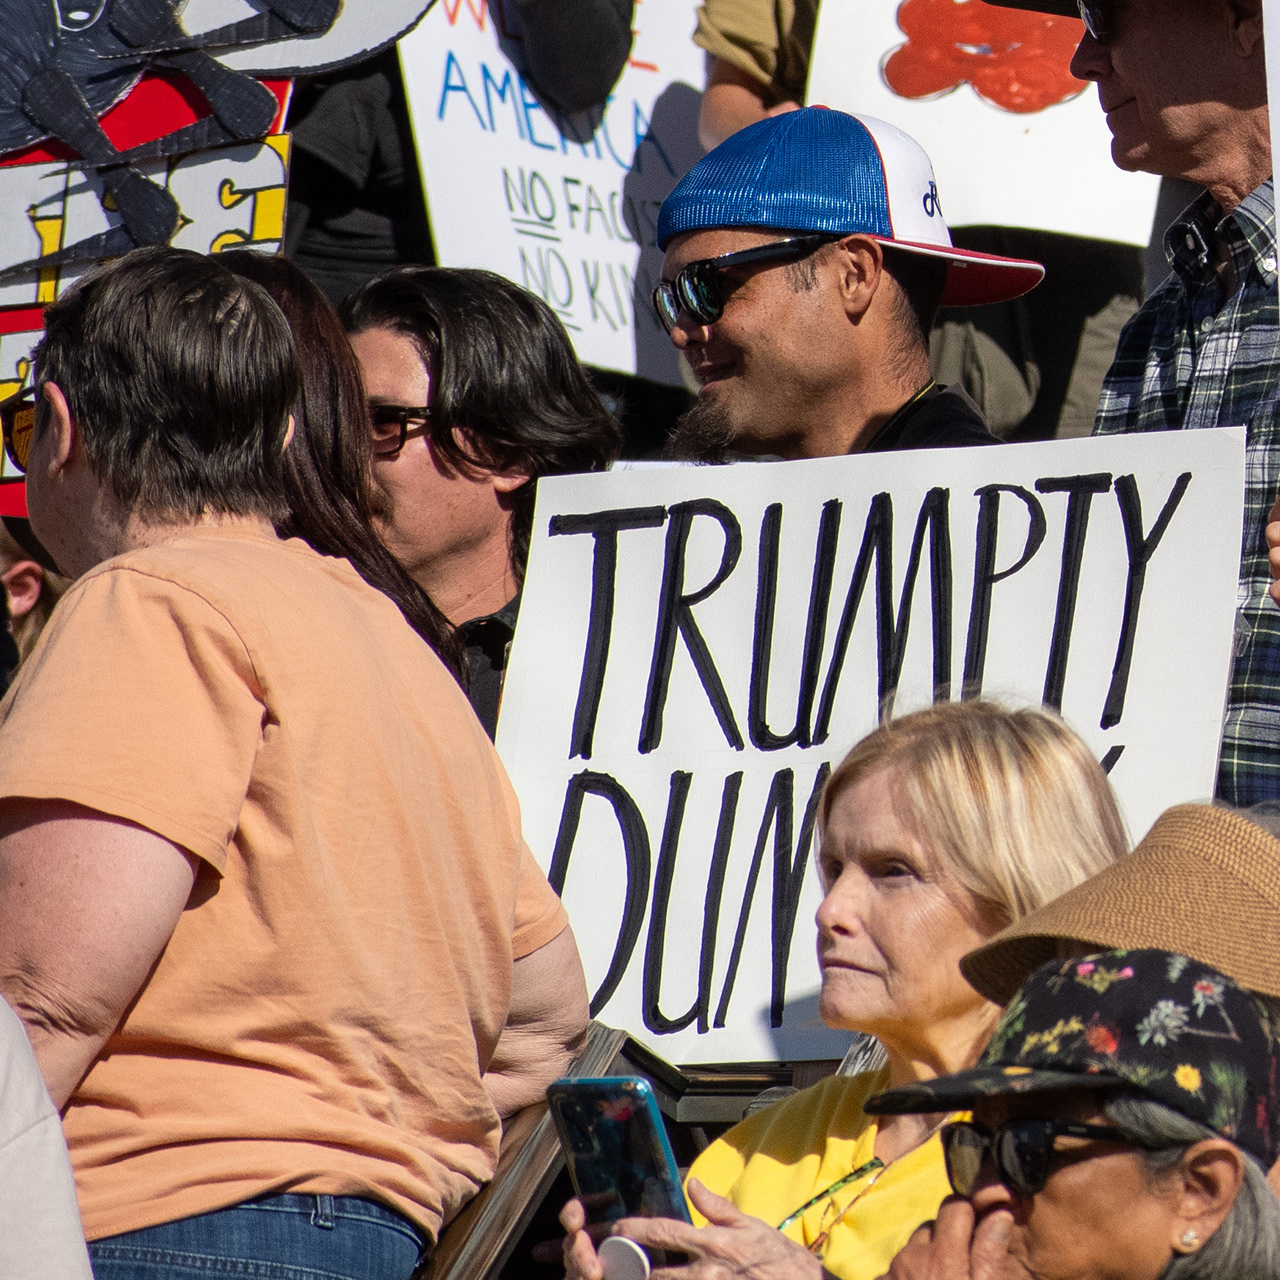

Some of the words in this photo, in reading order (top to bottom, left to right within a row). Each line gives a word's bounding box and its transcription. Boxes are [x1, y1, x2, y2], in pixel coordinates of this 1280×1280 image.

[501, 166, 557, 223] NO
[518, 245, 574, 312] NO
[547, 471, 1193, 760] TRUMPTY
